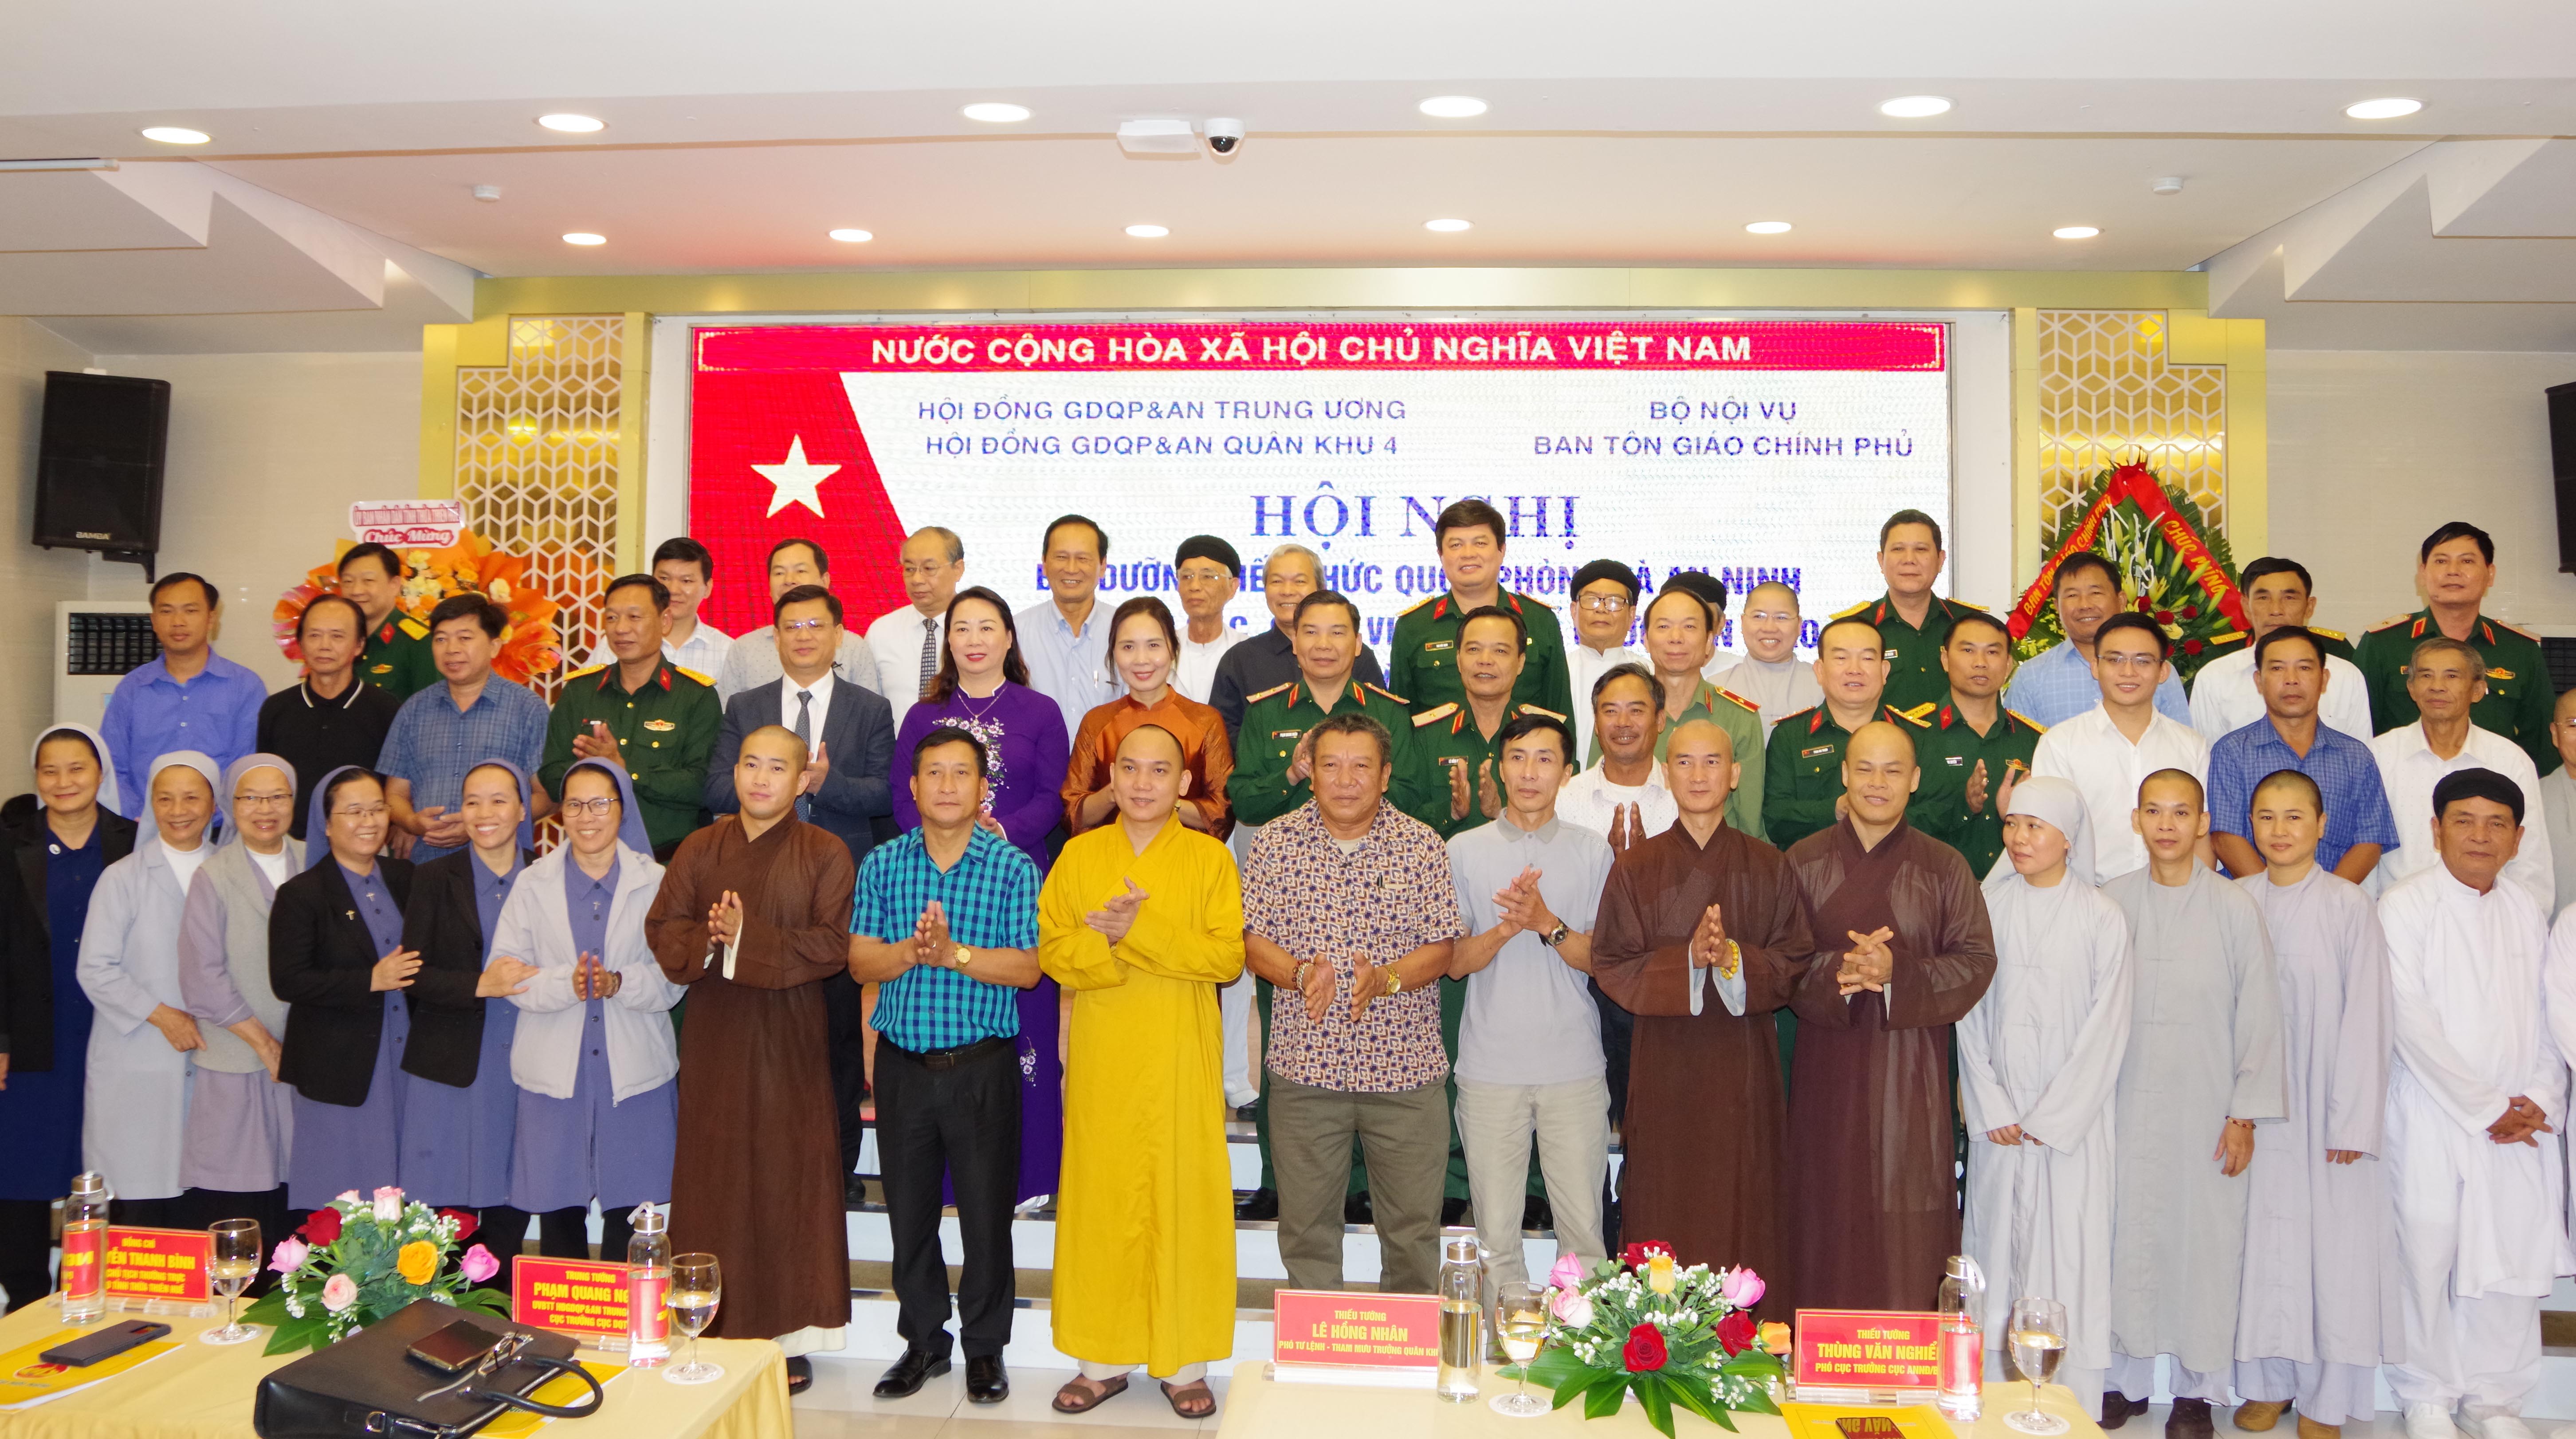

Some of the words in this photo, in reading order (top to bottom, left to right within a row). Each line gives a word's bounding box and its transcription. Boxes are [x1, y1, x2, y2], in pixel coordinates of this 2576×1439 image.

[872, 334, 975, 364] NƯỚC
[987, 332, 1095, 367] CỘNG
[1109, 332, 1188, 362] HÒA
[1200, 331, 1250, 361] XÃ
[1263, 330, 1327, 366] HỘI
[1339, 327, 1420, 362] CHỦ
[1433, 330, 1556, 361] NGHĨA
[1567, 330, 1653, 365] VIỆT
[1666, 336, 1751, 361] NAM
[919, 397, 962, 424] HỘI
[974, 394, 1052, 419] ĐỒNG
[1064, 401, 1203, 419] GDQP&AN
[1214, 401, 1313, 419] TRUNG
[1325, 398, 1406, 419] ƯƠNG
[1650, 396, 1690, 425] BỘ
[1700, 396, 1748, 425] NỘI
[1759, 401, 1796, 425] VỤ
[927, 432, 971, 458] HỘI
[982, 428, 1060, 455] ĐỒNG
[1072, 436, 1212, 455] GDQP&AN
[1223, 431, 1303, 455] QUÂN
[1315, 436, 1373, 455] KHU
[1384, 436, 1397, 455] 4
[1535, 436, 1593, 455] BAN
[1604, 430, 1661, 455] TÔN
[1673, 430, 1744, 456] GIÁO
[1753, 431, 1842, 456] CHÍNH
[1855, 429, 1912, 457] PHỦ
[1250, 481, 1377, 550] HỘI
[1400, 495, 1581, 550] NHỊ
[2164, 520, 2200, 554] CHÚC
[1100, 557, 1178, 592] DƯỠN
[1324, 558, 1382, 594] HỨC
[1497, 558, 1579, 595] PHÒN
[2024, 588, 2043, 616] BAN
[534, 1282, 569, 1300] PHẠM
[571, 1285, 612, 1302] QUANG
[1334, 1309, 1358, 1320] THIẾU
[1359, 1310, 1386, 1321] TƯỚNG
[1312, 1321, 1327, 1338] LÊ
[1331, 1321, 1368, 1341] HỒNG
[1370, 1325, 1408, 1342] NHÂN
[1857, 1328, 1881, 1339] THIẾU
[1883, 1329, 1910, 1340] TƯỚNG
[1279, 1339, 1294, 1349] PHÓ
[1296, 1341, 1306, 1350] TƯ
[1306, 1340, 1325, 1352] LỆNH
[1331, 1343, 1353, 1353] THAM
[1354, 1344, 1371, 1353] MƯU
[1373, 1343, 1402, 1355] TRƯỞNG
[1404, 1345, 1424, 1356] QUÂN
[1817, 1341, 1861, 1359] THÙNG
[1865, 1342, 1893, 1360] VĂN
[1896, 1341, 1938, 1360] NGHIỂ
[1815, 1361, 1833, 1372] PHÓ
[1834, 1363, 1852, 1374] CỤC
[1853, 1361, 1886, 1374] TRƯỞNG
[1888, 1365, 1905, 1376] CỤC
[1907, 1365, 1938, 1375] ANNĐ/B
